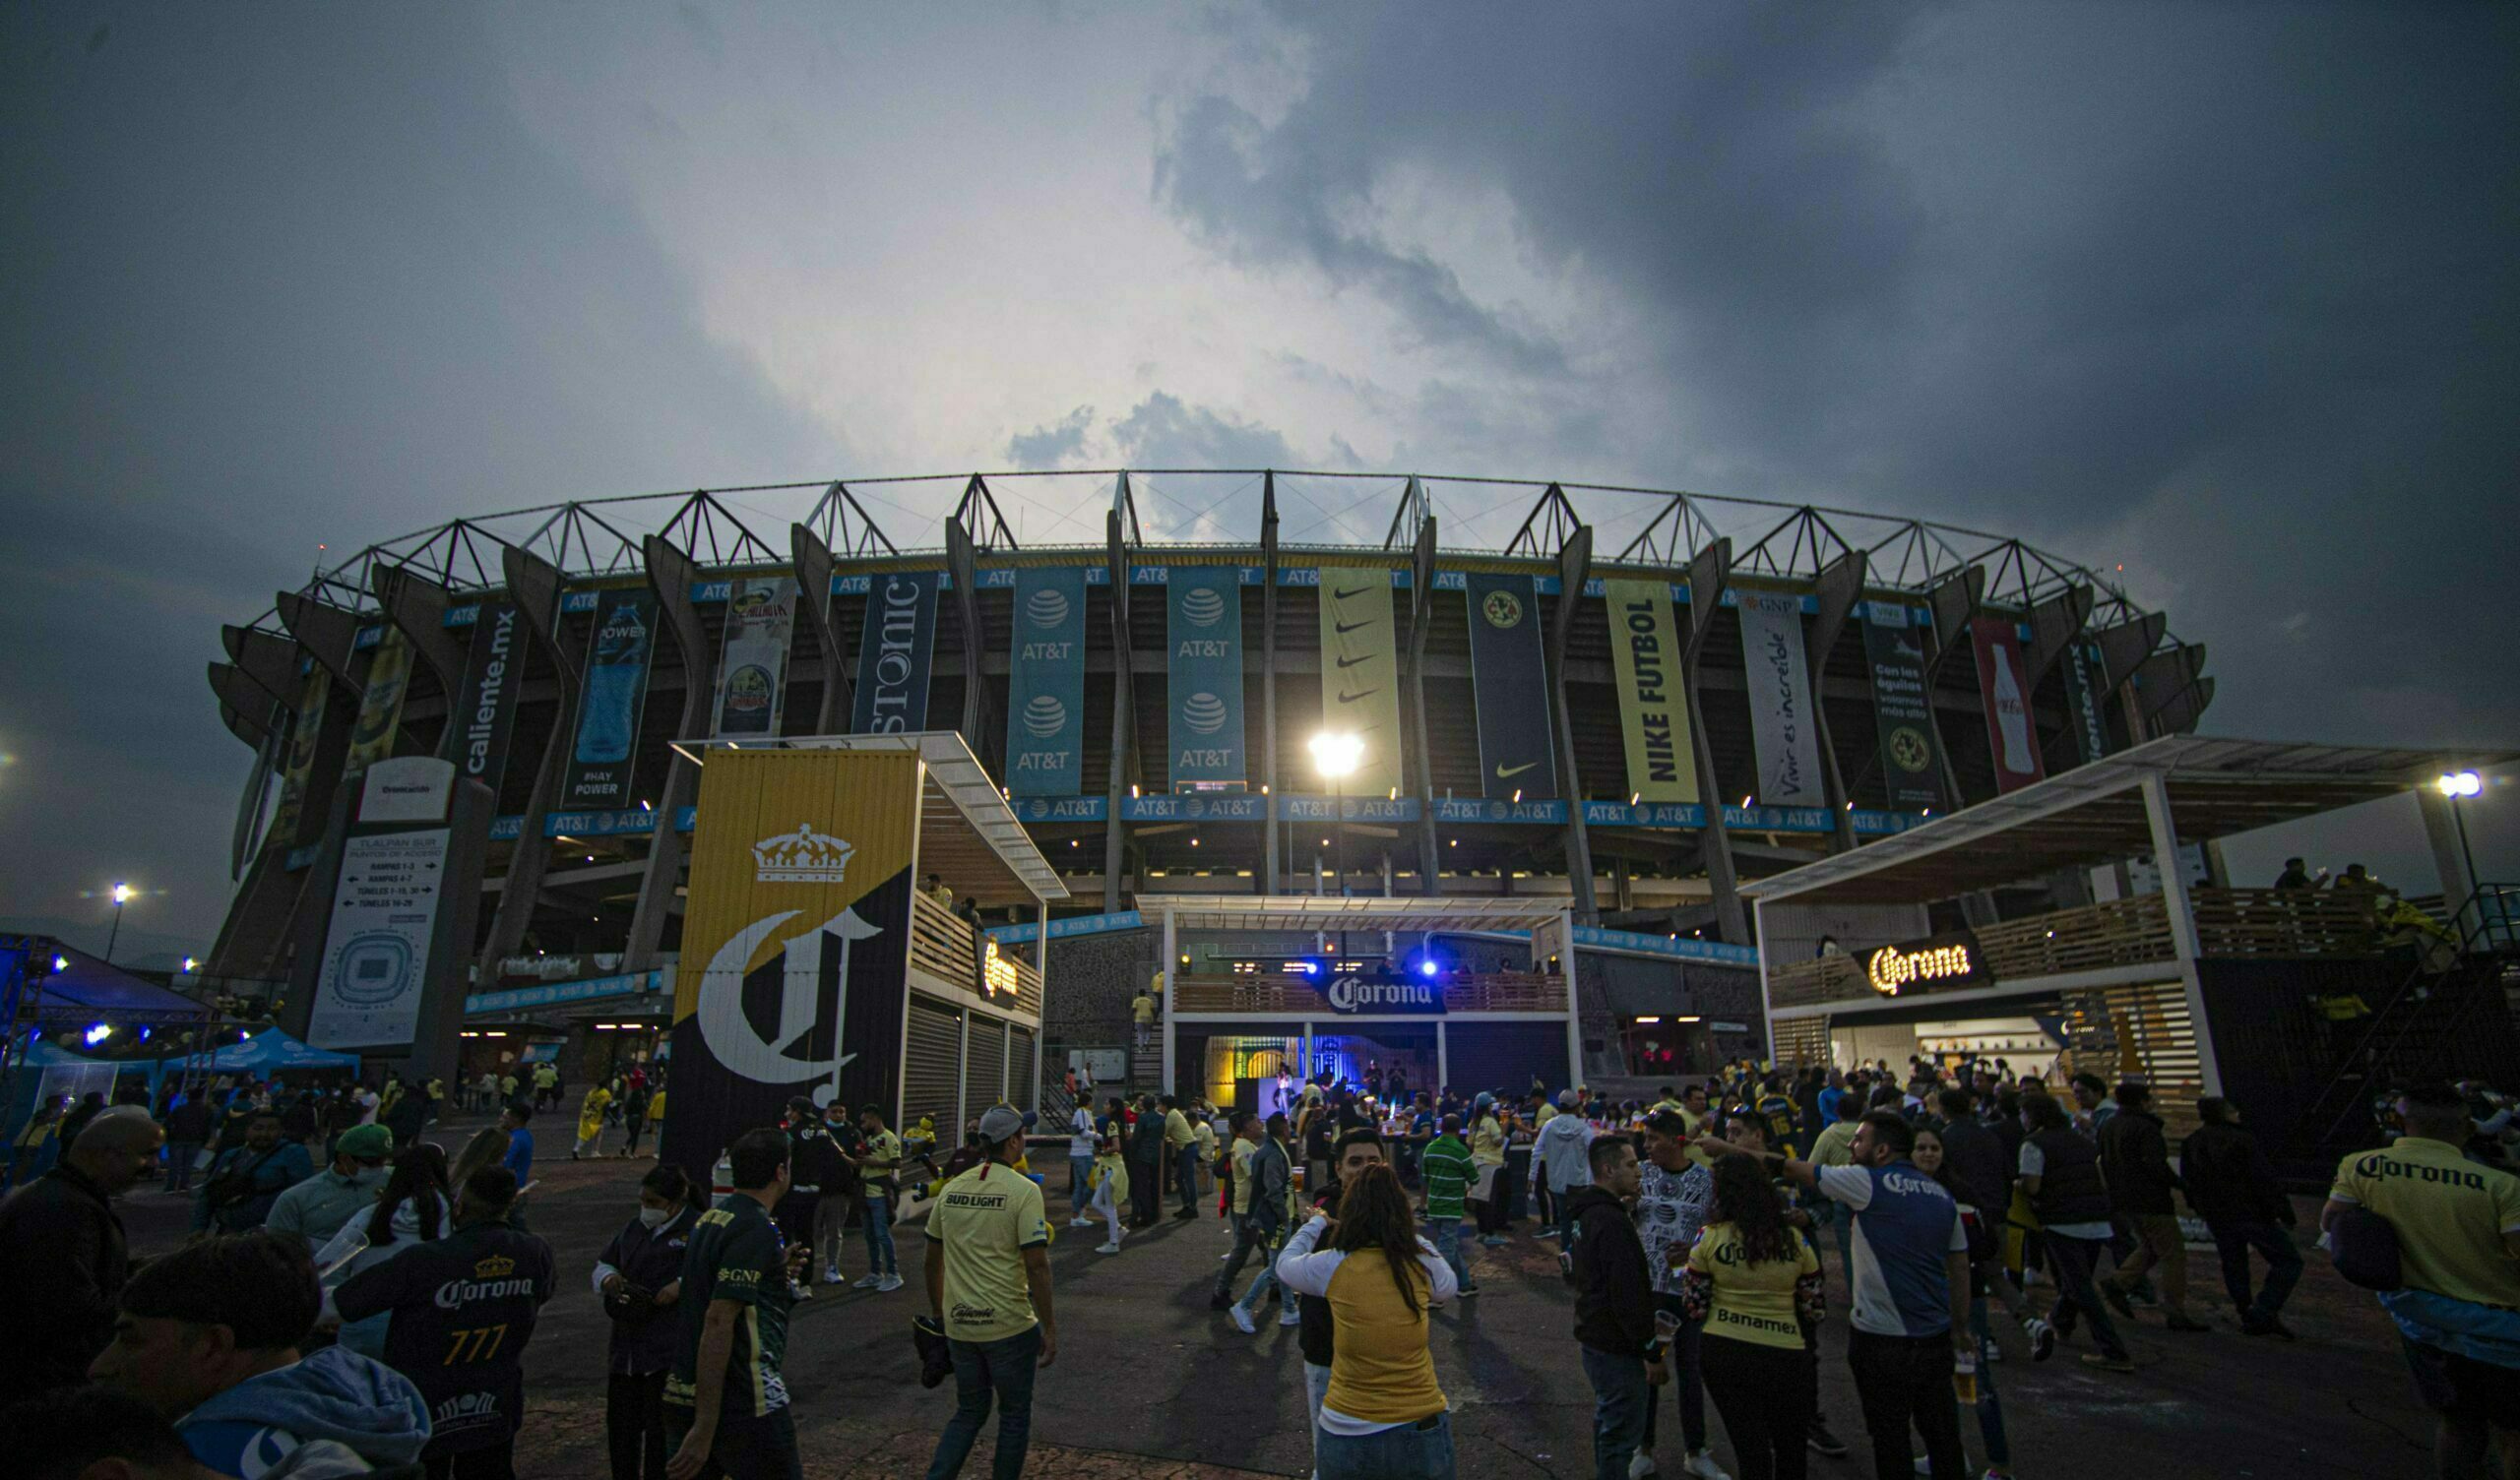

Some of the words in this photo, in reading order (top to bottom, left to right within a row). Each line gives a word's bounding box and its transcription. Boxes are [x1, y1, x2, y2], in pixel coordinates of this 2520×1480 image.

[1137, 566, 1167, 582] AT&
[1287, 569, 1319, 585] AT&
[1436, 571, 1466, 588] AT&
[702, 581, 730, 600] AT&
[839, 576, 870, 592] AT&
[569, 592, 598, 610] AT&
[1760, 600, 1792, 614] GNP
[1022, 643, 1072, 660] AT&T
[1179, 640, 1229, 657] AT&T
[1627, 598, 1667, 704] FUTBOL
[468, 609, 517, 774] caliente.mx
[1643, 712, 1677, 782] NIKE
[1017, 752, 1069, 770] AT&T
[1180, 749, 1231, 768] AT&T
[575, 783, 619, 796] POWER
[1053, 799, 1099, 815] AT&T
[1133, 799, 1178, 815] AT&T
[1209, 799, 1254, 815] AT&T
[1362, 800, 1407, 816] AT&T
[1440, 802, 1481, 818] AT&T
[1512, 803, 1554, 819] AT&T
[1588, 805, 1627, 822] AT&T
[1655, 806, 1694, 823] AT&T
[553, 816, 592, 832] AT&T
[617, 812, 657, 829] AT&T
[1725, 807, 1760, 824] AT&T
[1786, 809, 1823, 826] AT&T
[1868, 945, 1972, 996] Corona
[1329, 976, 1433, 1013] Corona
[2356, 1154, 2487, 1192] Corona
[1882, 1172, 1951, 1202] Corona
[946, 1195, 970, 1205] BUD
[971, 1196, 1004, 1207] LIGHT
[730, 1268, 762, 1283] GNP
[434, 1278, 533, 1311] Corona
[443, 1323, 509, 1366] 777
